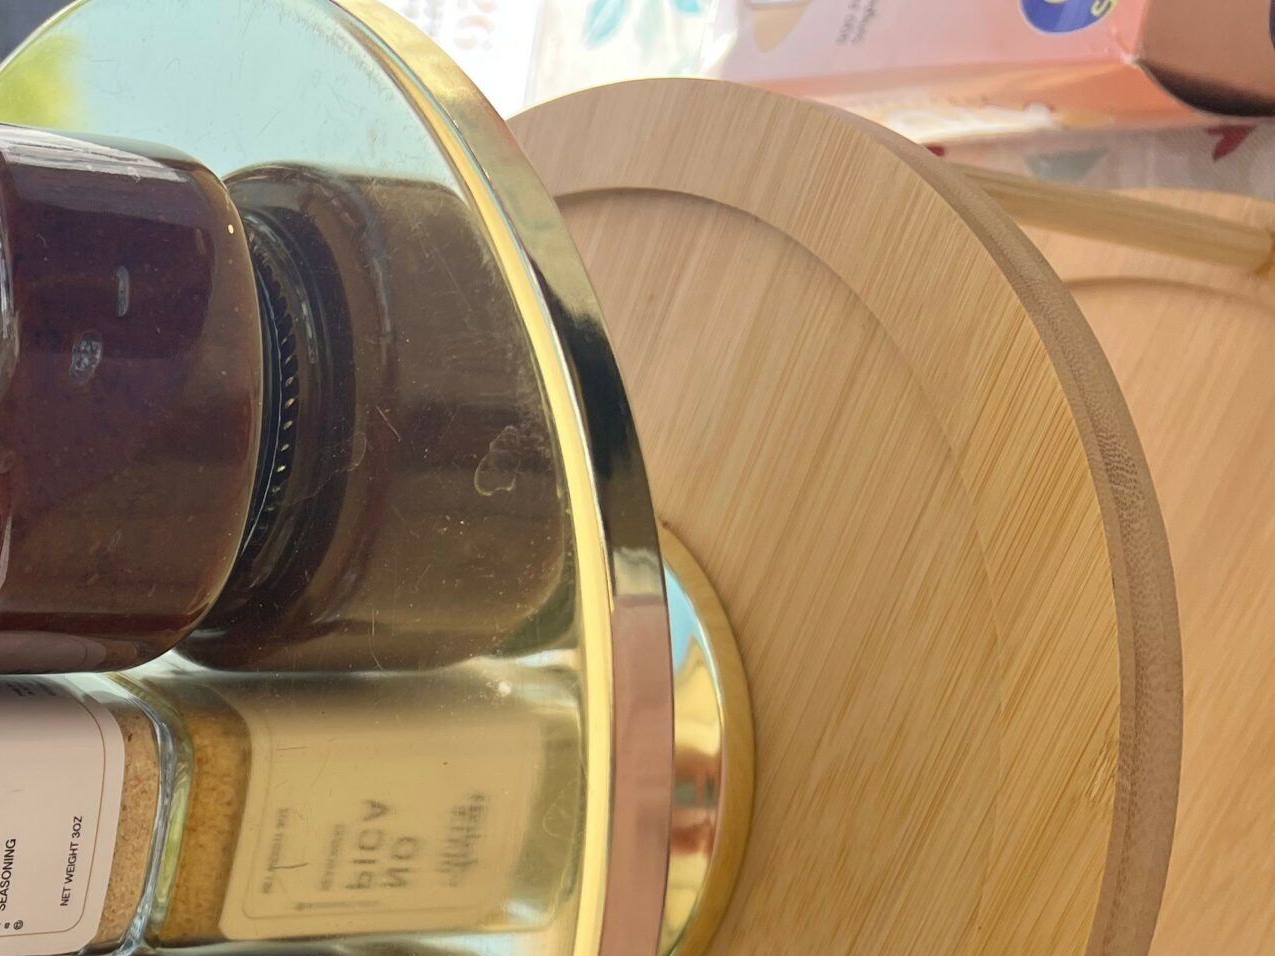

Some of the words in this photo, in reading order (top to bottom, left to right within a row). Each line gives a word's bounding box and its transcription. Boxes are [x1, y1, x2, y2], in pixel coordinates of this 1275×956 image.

[71, 814, 83, 838] 3OZ
[63, 840, 80, 884] WEIGHT
[59, 885, 71, 906] NET
